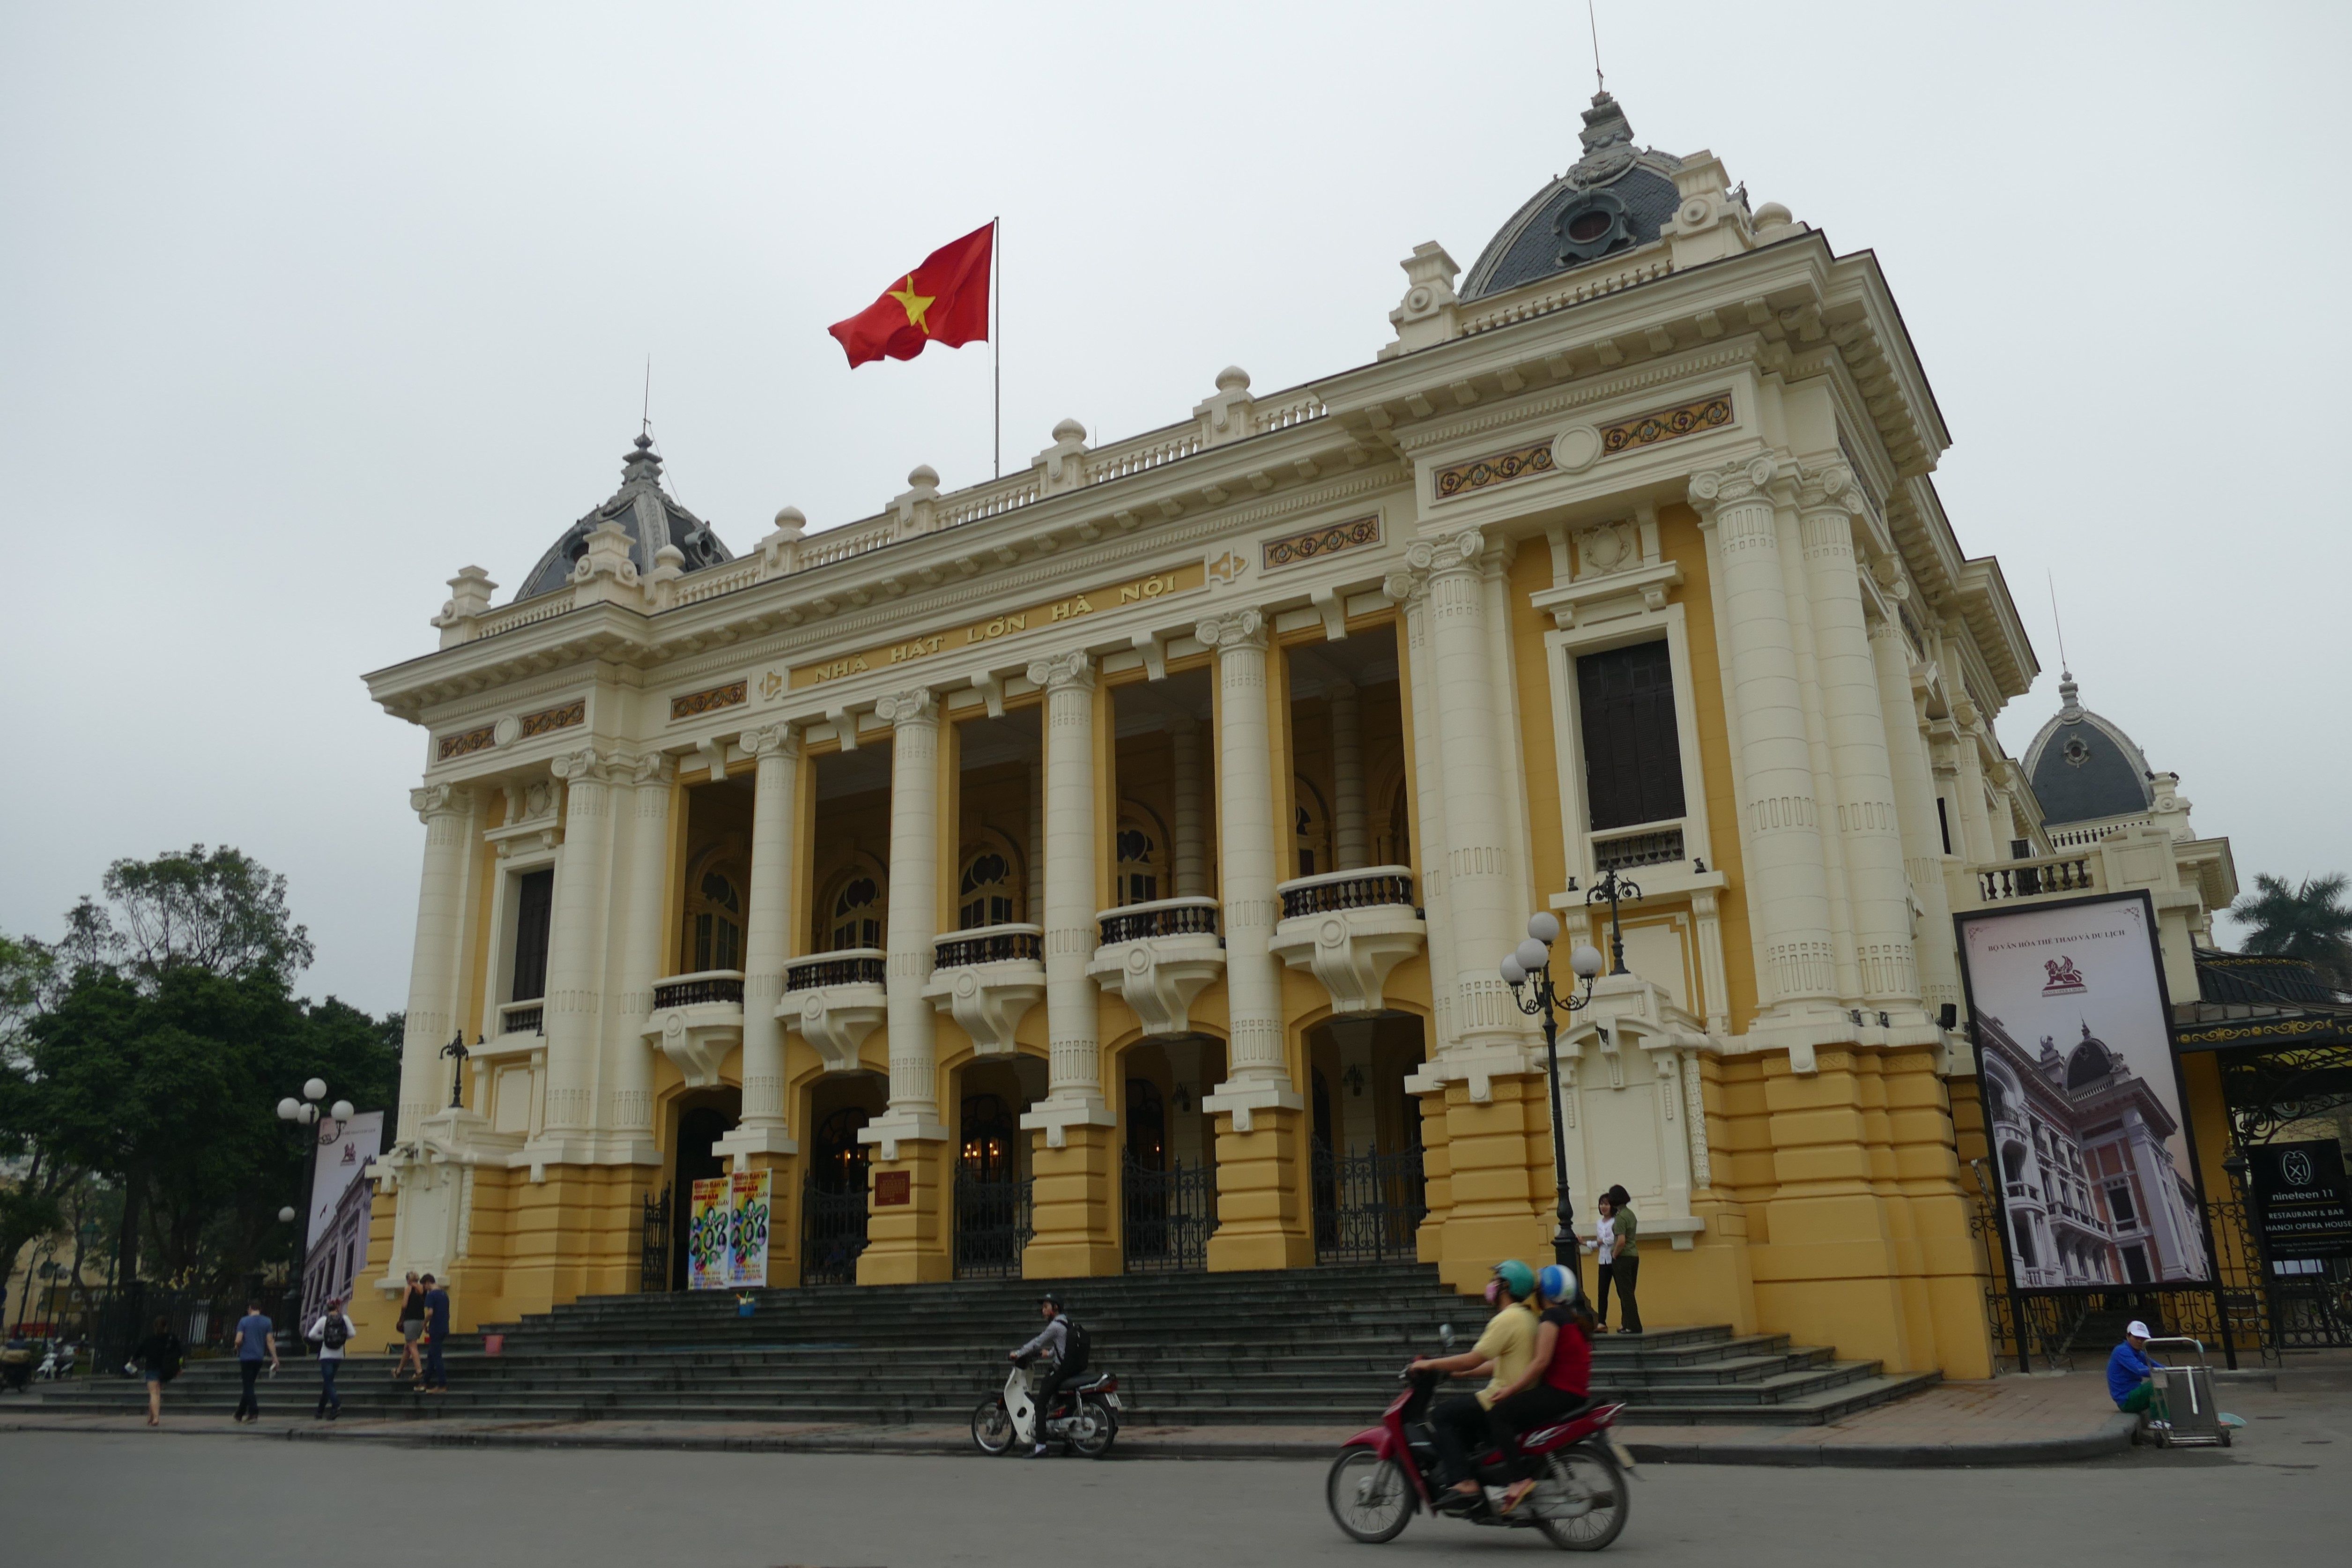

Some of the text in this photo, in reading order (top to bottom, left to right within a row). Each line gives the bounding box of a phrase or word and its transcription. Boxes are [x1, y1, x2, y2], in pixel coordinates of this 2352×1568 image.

[815, 575, 1175, 684] NHÀ HÁT LỚN HÀ NỘI
[2055, 935, 2077, 944] THAO
[2105, 929, 2125, 938] LỊCH
[2272, 1191, 2319, 1201] nineteen
[2268, 1210, 2317, 1219] RESTAURANT
